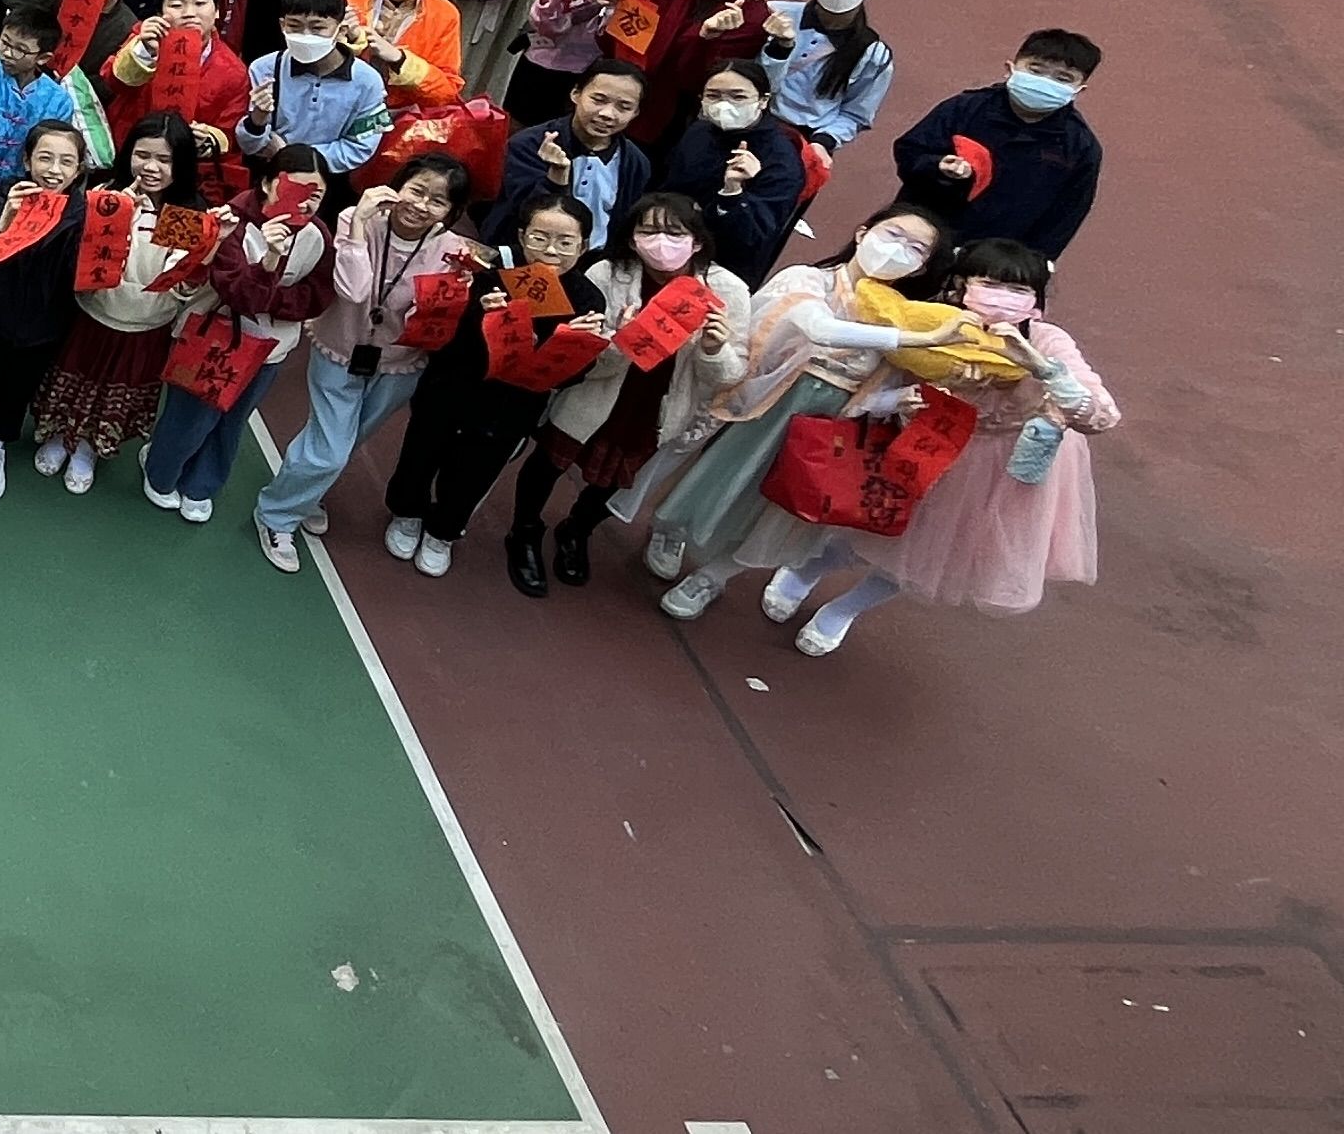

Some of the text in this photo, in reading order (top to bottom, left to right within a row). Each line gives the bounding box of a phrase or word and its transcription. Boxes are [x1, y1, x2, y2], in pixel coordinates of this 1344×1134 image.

[617, 5, 650, 38] 福
[163, 36, 188, 96] 前程似
[515, 268, 549, 303] 福
